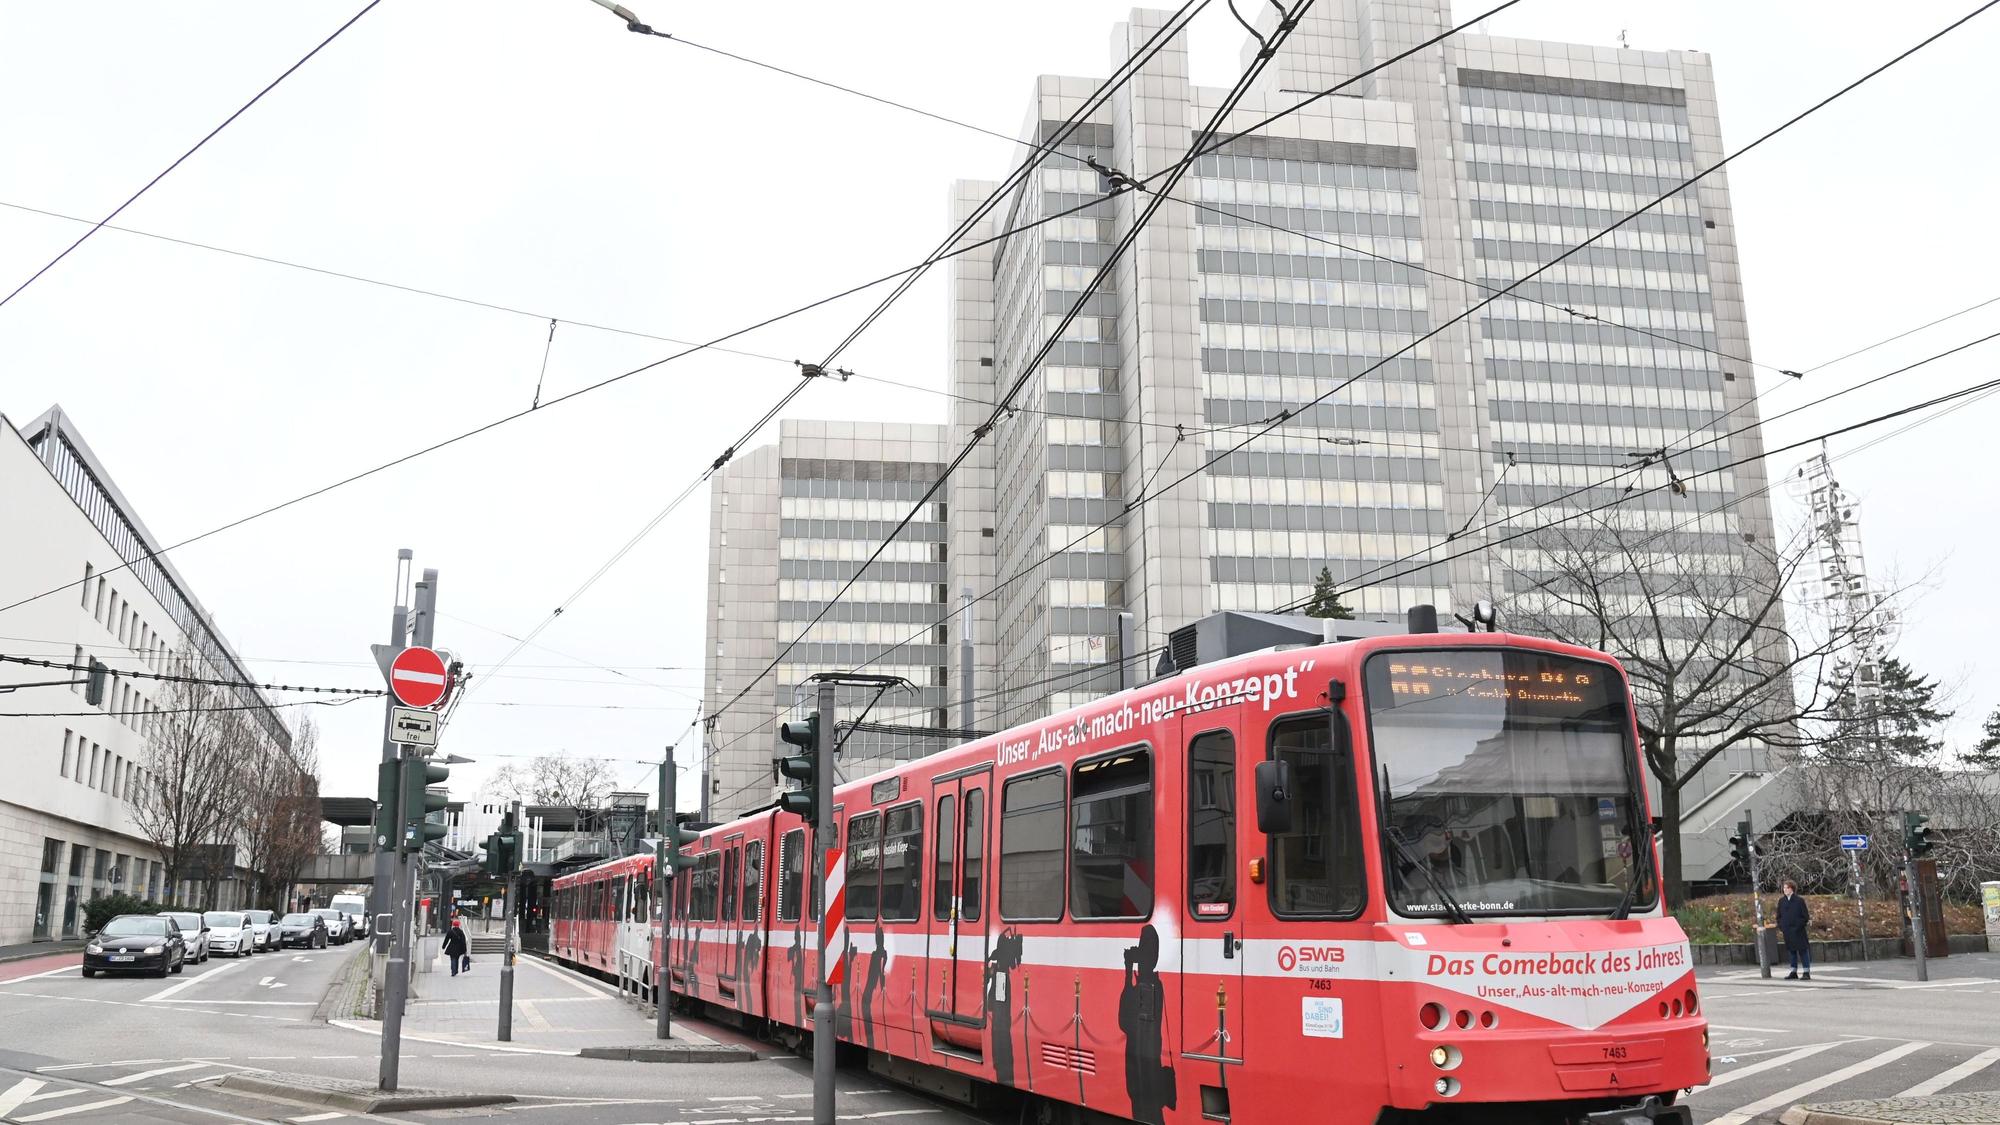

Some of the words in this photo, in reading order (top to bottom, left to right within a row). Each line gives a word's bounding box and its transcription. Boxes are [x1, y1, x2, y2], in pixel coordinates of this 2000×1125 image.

[406, 731, 420, 742] frei
[997, 738, 1030, 766] Unser
[1299, 947, 1345, 962] SWB
[1427, 953, 1475, 976] Das
[1482, 952, 1596, 976] Comeback
[1602, 951, 1631, 974] des
[1635, 945, 1685, 972] Jahres!
[1299, 964, 1310, 972] Bus
[1311, 964, 1323, 973] und
[1324, 964, 1340, 973] Bahn
[1309, 979, 1332, 990] 7463
[1477, 985, 1516, 998] Unser
[1602, 1047, 1627, 1059] 7463
[1610, 1072, 1618, 1084] A
